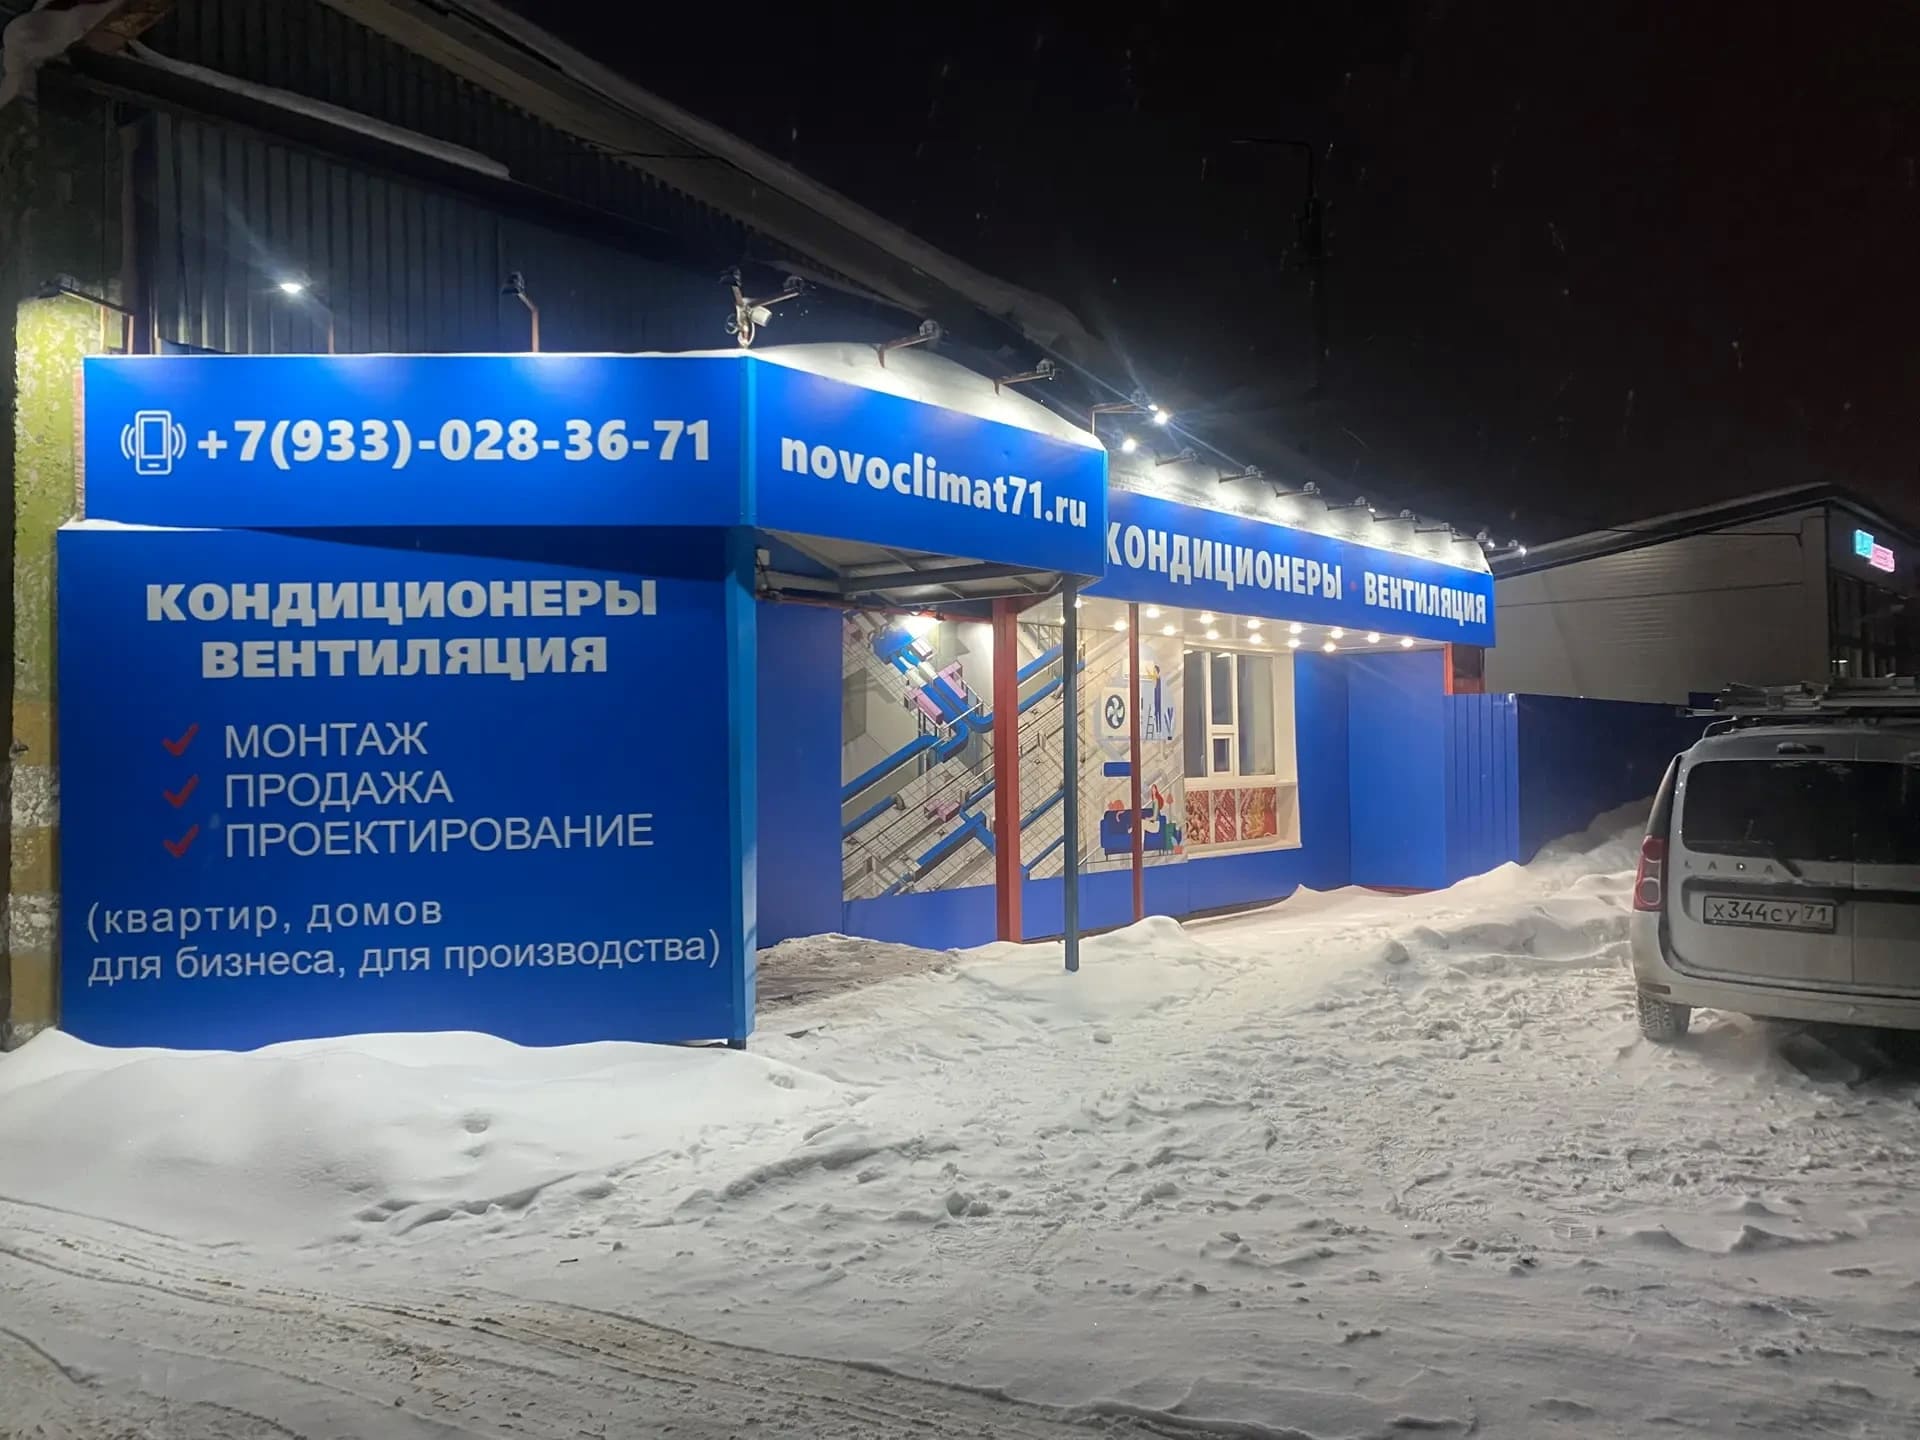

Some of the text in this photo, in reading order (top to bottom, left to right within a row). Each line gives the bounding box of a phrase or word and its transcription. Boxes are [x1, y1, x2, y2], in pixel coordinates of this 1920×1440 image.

[198, 420, 709, 469] +7(933)-028-36-71
[781, 437, 1087, 527] novoclimat71.ru
[1107, 522, 1487, 626] КОНДИЦИОНЕРЫ ВЕНТИЛЯЦИЯ
[147, 580, 657, 627] КОНДИЦИОНЕРЫ
[202, 637, 607, 681] ВЕНТИЛЯЦИЯ
[225, 722, 428, 759] МОНТАЖ
[226, 771, 454, 813] ПРОДАЖА
[226, 814, 654, 858] ПРОЕКТИРОВАНИЕ
[88, 901, 442, 943] (квартир, домов
[88, 929, 720, 986] для бизнеса, для производства)
